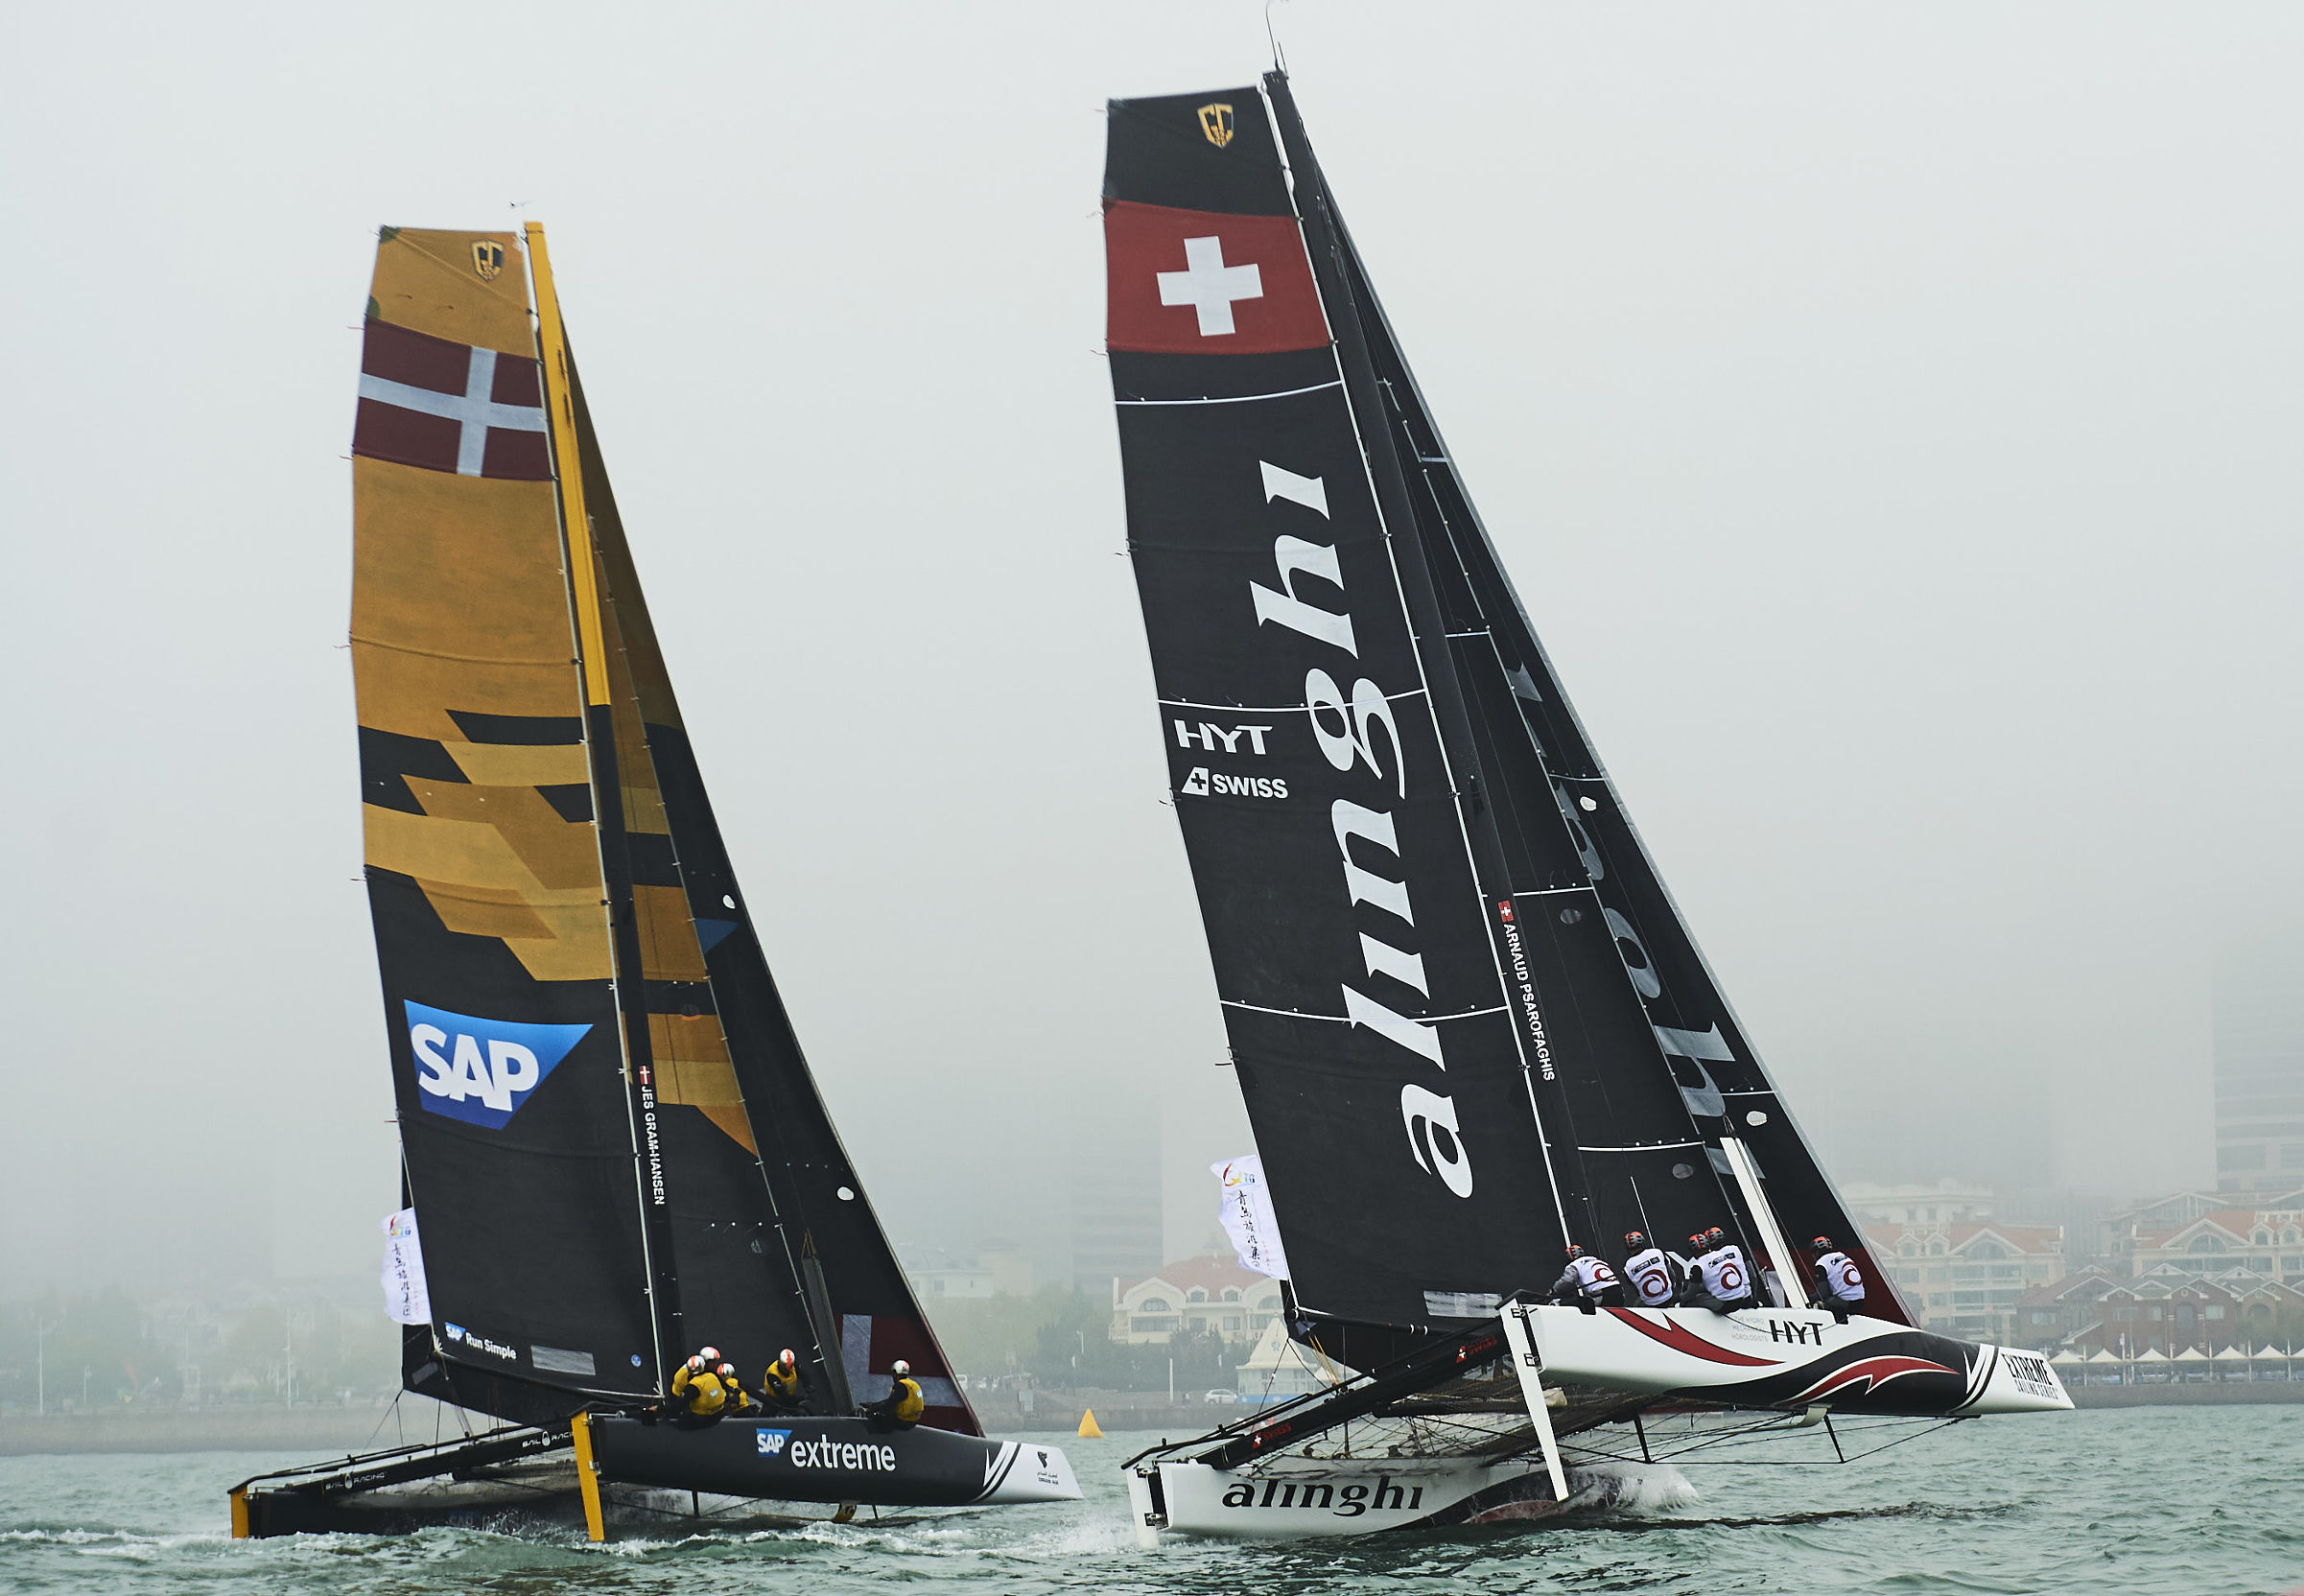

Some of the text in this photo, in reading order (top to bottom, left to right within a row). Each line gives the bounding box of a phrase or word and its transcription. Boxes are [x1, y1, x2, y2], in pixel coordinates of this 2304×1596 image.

[1174, 719, 1273, 755] HYT
[1211, 773, 1289, 799] SWISS
[1250, 460, 1473, 1199] alinghi
[1504, 923, 1555, 1081] ARNAUD PSAROFAGHIS
[411, 1022, 540, 1112] SAP
[641, 1085, 665, 1206] JES GRAM-HANSEN
[445, 1325, 462, 1342] SAP
[465, 1331, 517, 1360] Run Simple
[1769, 1319, 1823, 1347] HYT
[2002, 1353, 2053, 1386] EXTREME
[757, 1433, 785, 1455] SAP
[791, 1434, 896, 1471] extreme
[1221, 1475, 1423, 1516] alinghi
